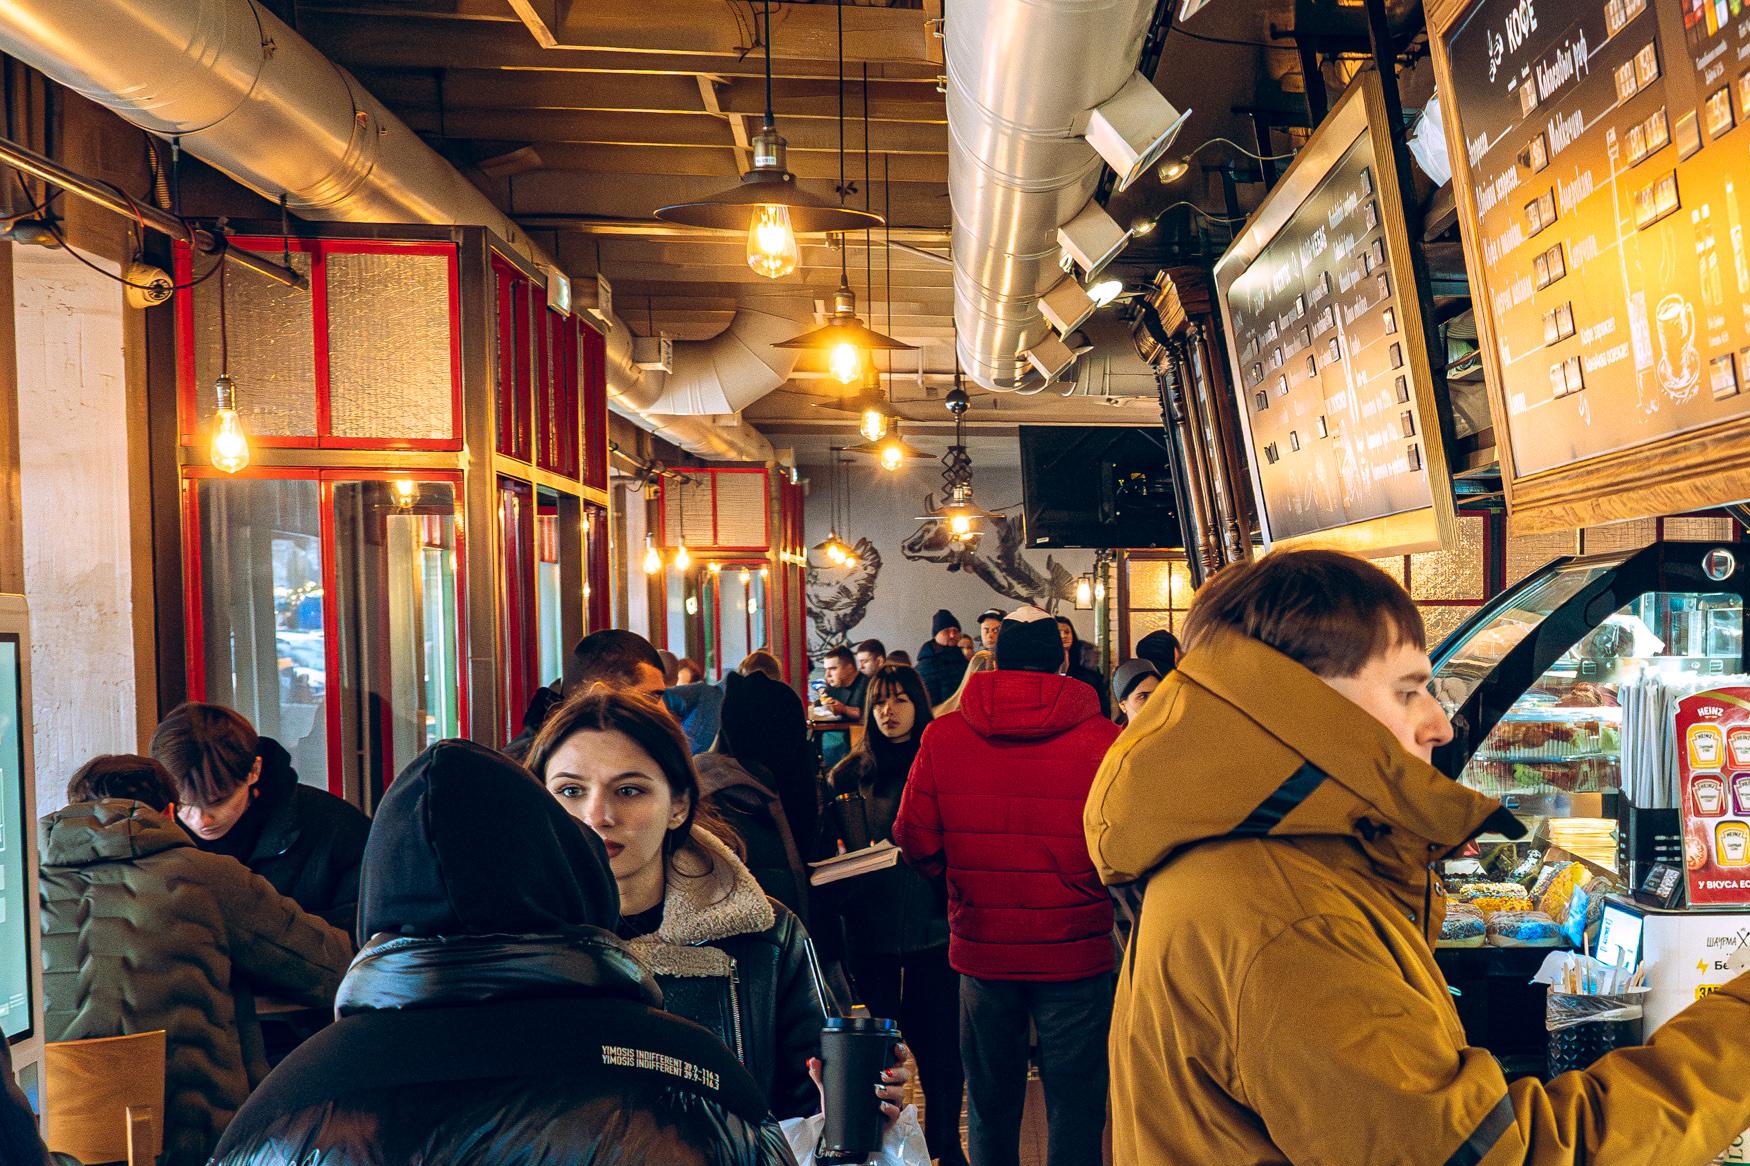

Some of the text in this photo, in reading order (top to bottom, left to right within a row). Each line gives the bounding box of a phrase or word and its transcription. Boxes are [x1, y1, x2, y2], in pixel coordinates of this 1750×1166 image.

[1697, 706, 1724, 716] HEINZ
[1698, 881, 1705, 889] У
[1707, 880, 1738, 889] ВКУСА
[602, 1045, 635, 1058] YIMOSIS
[636, 1049, 683, 1068] INDIFFERENT
[602, 1054, 635, 1067] YIMOSIS
[636, 1058, 683, 1077] INDIFFERENT
